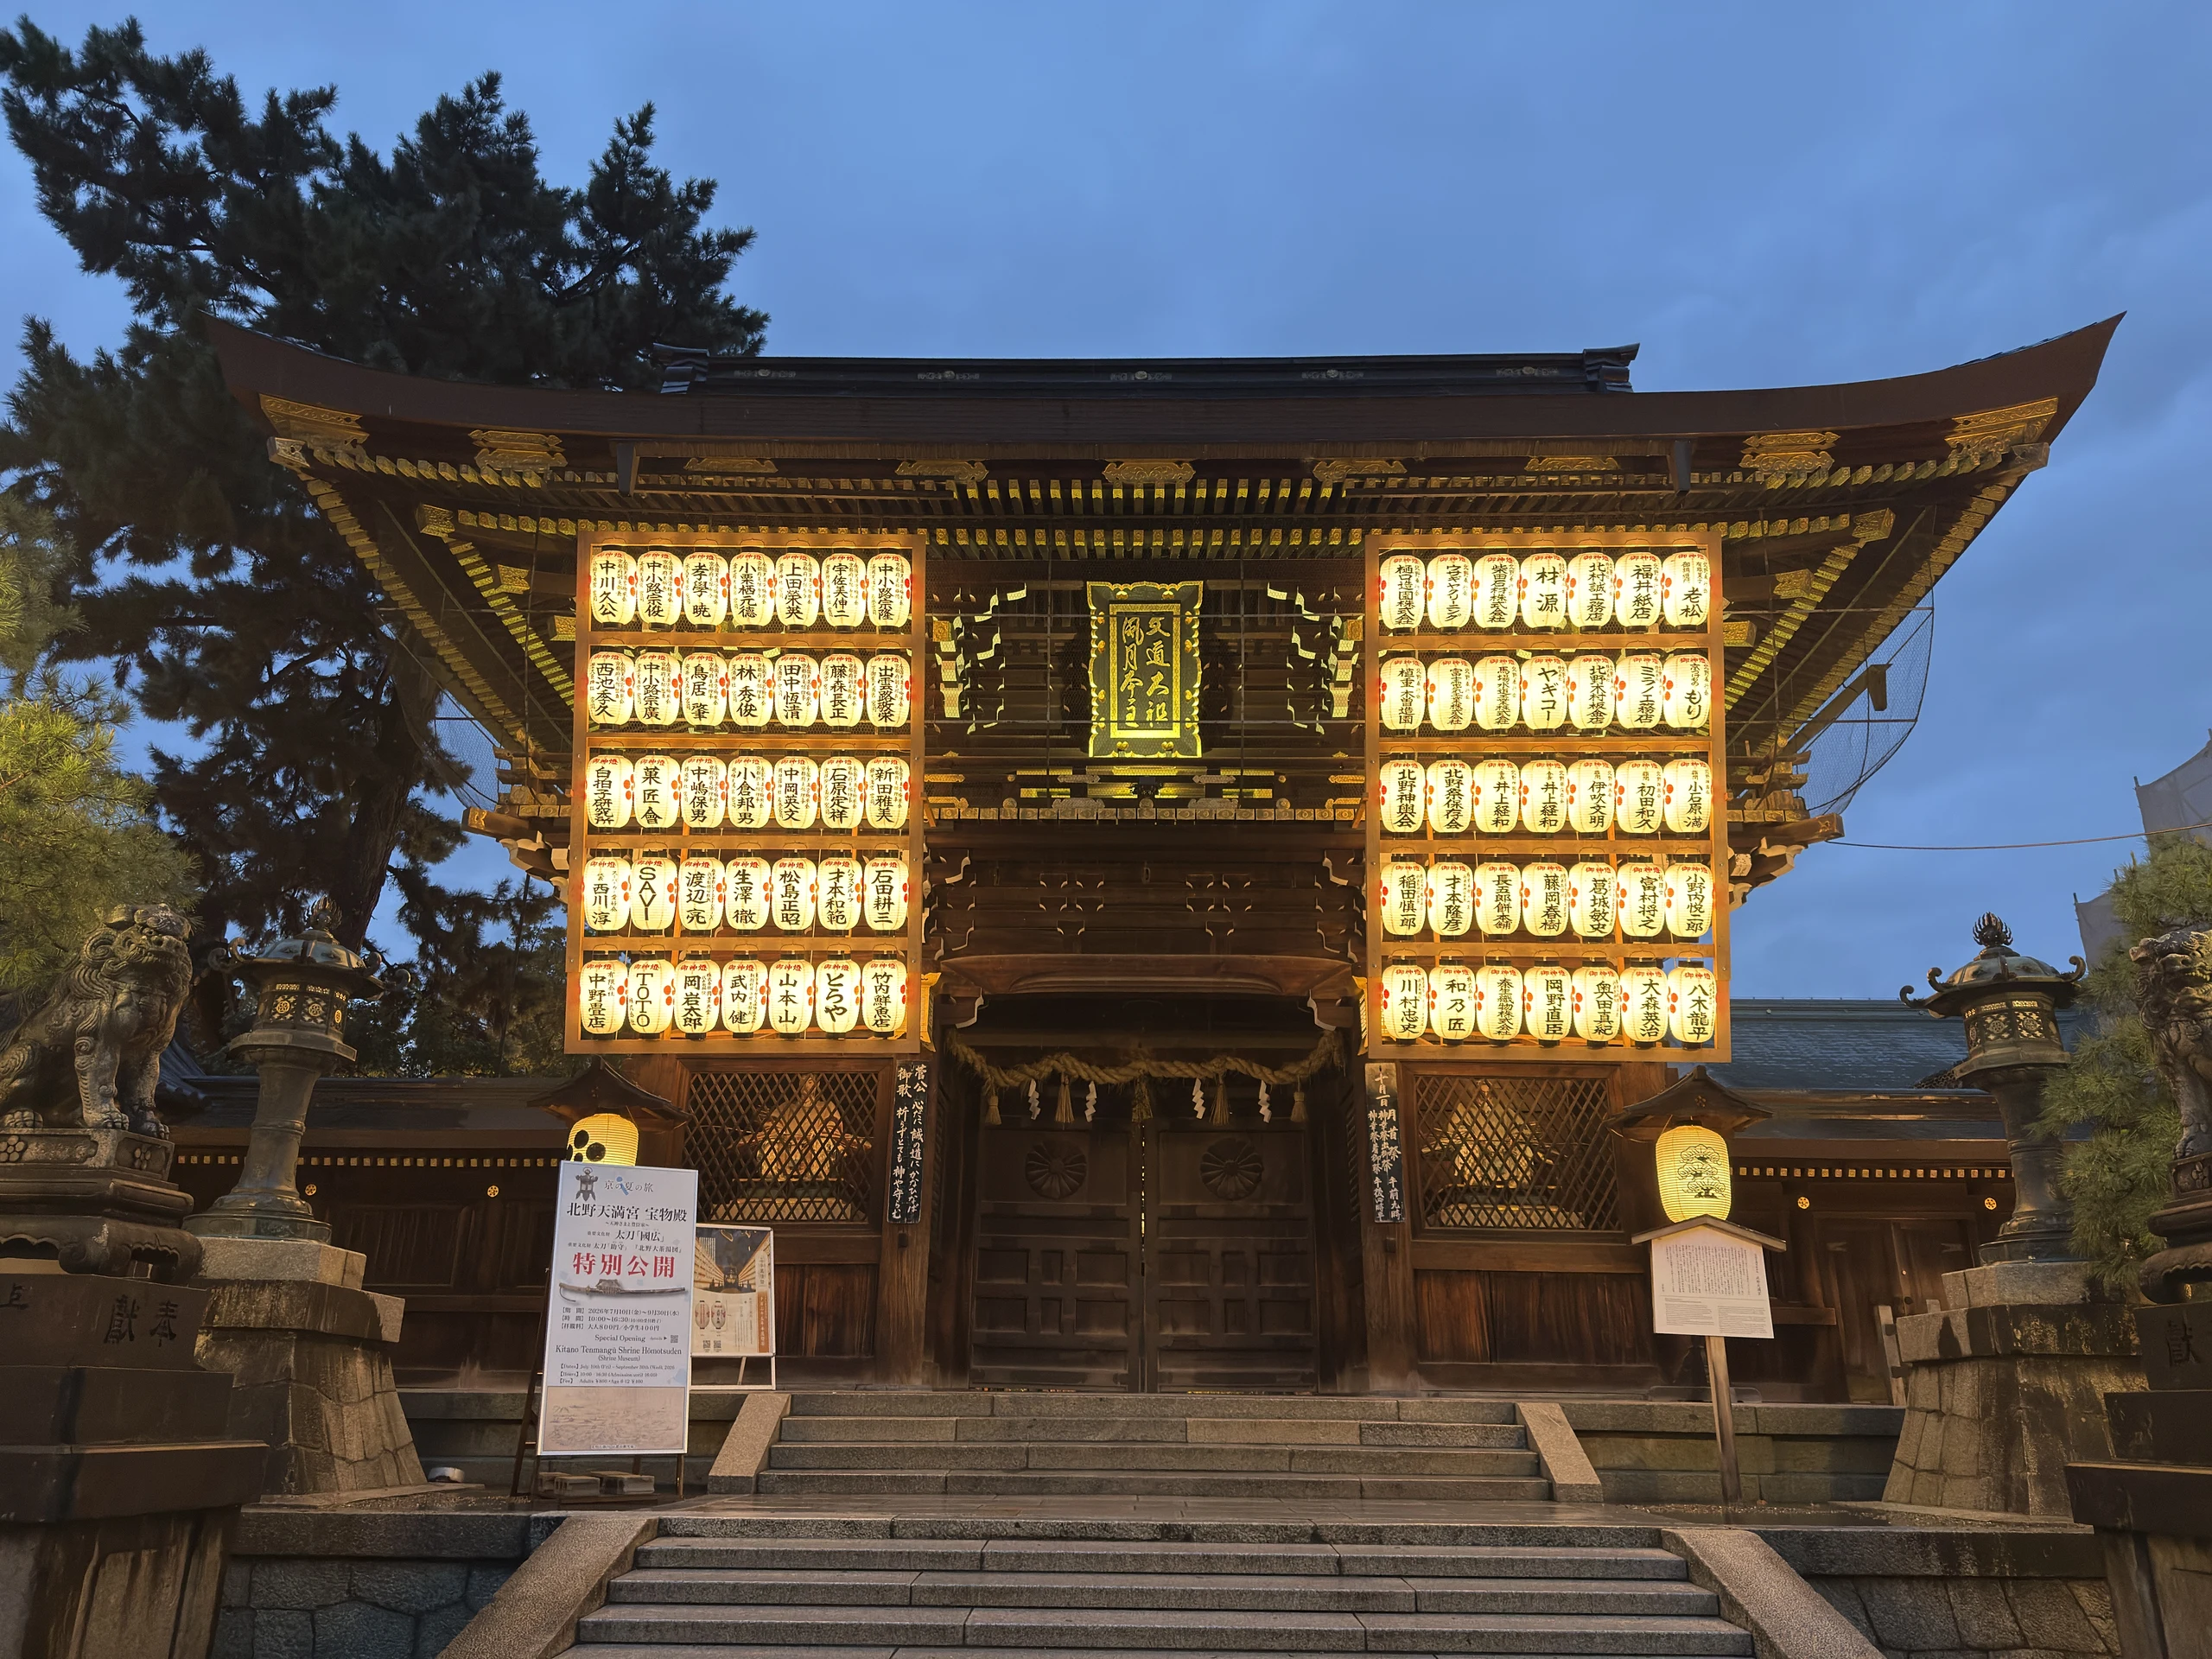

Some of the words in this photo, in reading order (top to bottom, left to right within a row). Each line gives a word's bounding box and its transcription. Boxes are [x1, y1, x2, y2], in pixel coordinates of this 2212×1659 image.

[599, 560, 619, 617] 中川久公
[645, 561, 665, 617] 中小路宗俊
[785, 563, 805, 620] 上田榮英
[830, 563, 851, 617] 宇佐美伸二
[879, 563, 897, 620] 中小路宗隆
[1446, 565, 1461, 621] ウサギヤクリーニング
[1489, 564, 1510, 622] 柴田石材株式会社
[1536, 564, 1560, 613] 材源
[1586, 563, 1608, 623] 北村誠工務店
[1630, 565, 1653, 619] 福井紙店
[1681, 588, 1703, 617] 老松
[593, 663, 617, 716] 西池季久
[643, 663, 663, 720] 中小路宗廣
[734, 665, 760, 717] 林秀俊
[830, 664, 849, 719] 藤森長正
[1496, 667, 1510, 724] 馬場水道工業株式会社
[1538, 668, 1558, 721] ヤギコー
[1587, 665, 1609, 726] 北野木村板金店
[1635, 666, 1658, 725] ミラノ工務店
[1685, 690, 1701, 719] もり
[591, 766, 613, 826] 白拍子研究所
[737, 767, 755, 824] 小倉邦男
[782, 768, 800, 821] 中岡英文
[829, 768, 851, 823] 石原定祥
[873, 768, 896, 823] 新田雅美
[1394, 769, 1416, 828] 北野神輿会
[1445, 769, 1465, 830] 北野祭保存会
[1491, 781, 1510, 827] 井上経和
[1539, 782, 1558, 827] 井上経和
[1590, 782, 1609, 830] 伊吹文明
[1635, 783, 1657, 830] 初田和久
[1684, 782, 1702, 828] 小石原満
[592, 884, 613, 925] 西川淳
[779, 871, 800, 925] 松島正昭
[825, 868, 846, 924] 才本和範
[872, 870, 894, 923] 石田耕三
[1400, 874, 1419, 930] 稲田慎一郎
[1443, 874, 1465, 931] 才本隆彦
[1540, 874, 1564, 933] 藤岡春樹
[1587, 878, 1611, 935] 葛城敏史
[1686, 874, 1705, 935] 小野内悦二郎
[588, 974, 606, 1028] 中野畳店
[633, 974, 653, 1027] TOTO
[680, 976, 704, 1031] 岡岩太郎
[728, 974, 752, 1024] 武内健
[779, 974, 797, 1024] 山本山
[824, 974, 847, 1021] とらや
[872, 972, 893, 1027] 竹内鮮魚店
[1399, 980, 1421, 1033] 川村忠史
[1446, 978, 1468, 1031] 和乃匠
[1496, 978, 1514, 1035] 泰生織物株式会社
[1545, 980, 1567, 1037] 岡野直臣
[1641, 979, 1663, 1039] 大森英治
[1688, 985, 1711, 1042] 八木龍平
[897, 1067, 912, 1098] 御歌
[914, 1064, 927, 1093] 菅公
[1375, 1073, 1390, 1107] 十月一日
[896, 1106, 909, 1163] 祈らずとても
[910, 1128, 924, 1167] 誠の道に
[1388, 1109, 1401, 1161] 月首祭
[567, 1202, 639, 1220] 北野天満宮
[645, 1207, 687, 1222] 宝物殿
[605, 1181, 653, 1192] 京の夏の旅
[1389, 1176, 1401, 1220] 午前九時
[573, 1252, 675, 1278] 特別公開
